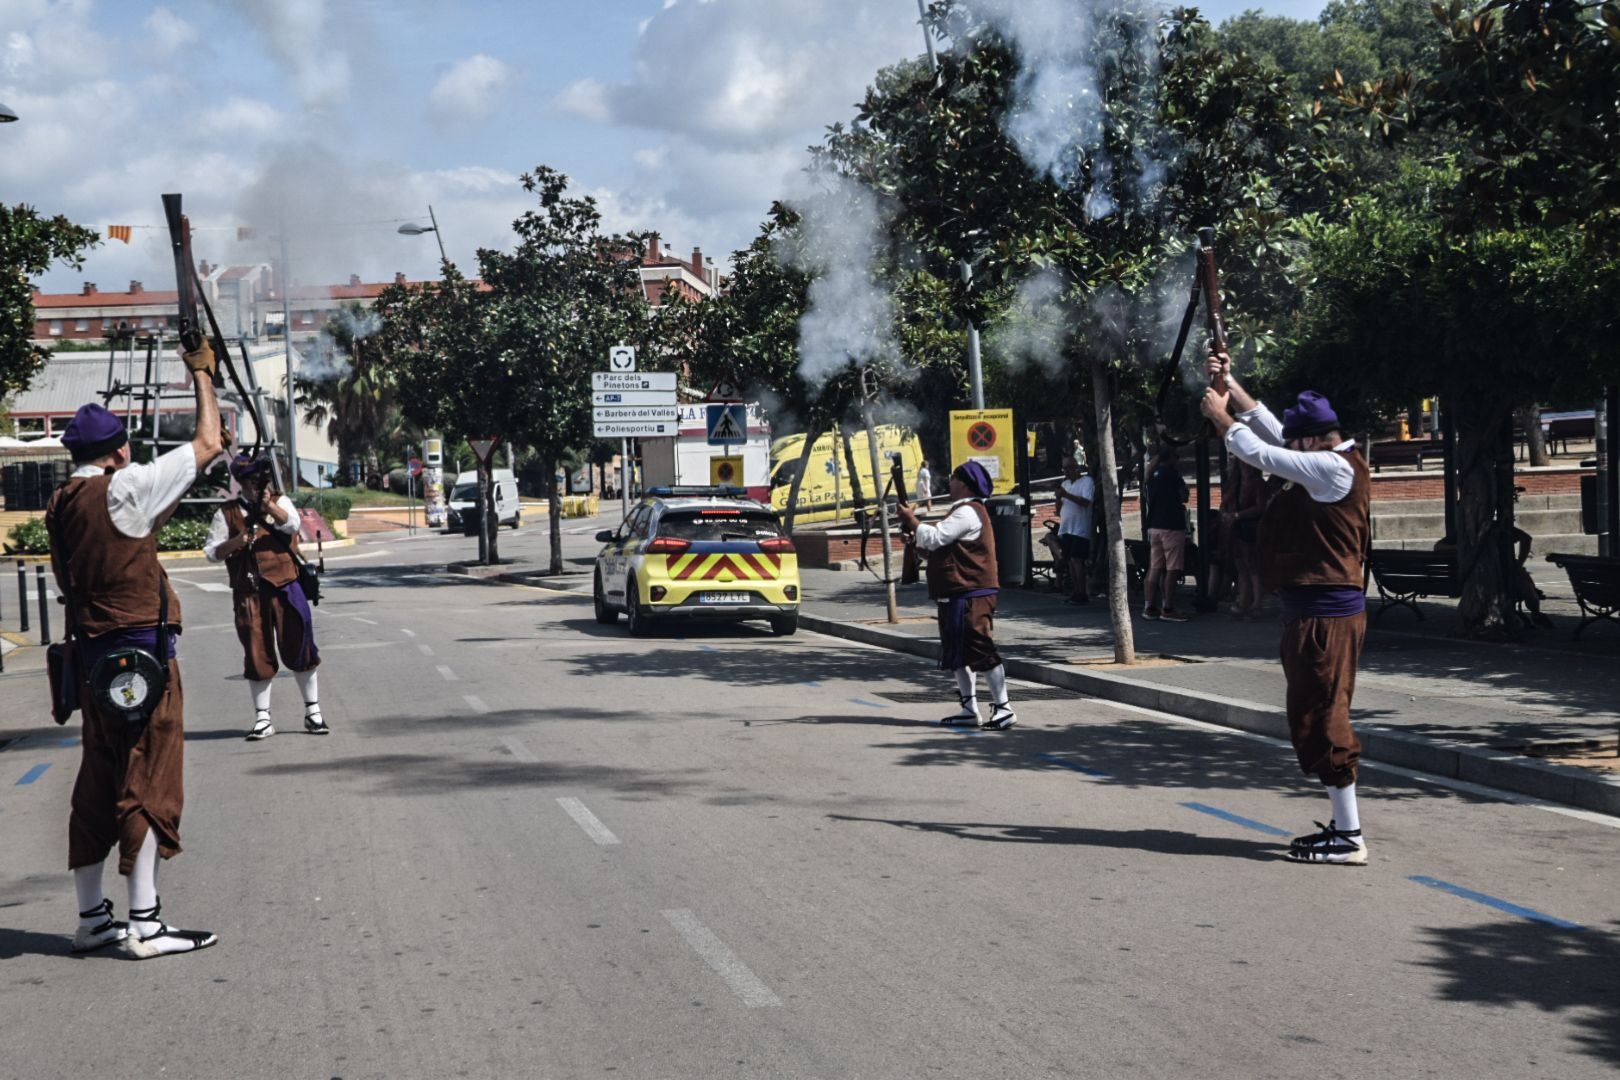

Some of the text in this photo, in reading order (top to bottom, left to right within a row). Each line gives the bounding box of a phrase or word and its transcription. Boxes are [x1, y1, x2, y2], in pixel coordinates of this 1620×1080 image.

[603, 381, 640, 389] Pinetons
[605, 425, 655, 433] Poliesportiu
[779, 497, 807, 507] Gp
[809, 494, 822, 503] La
